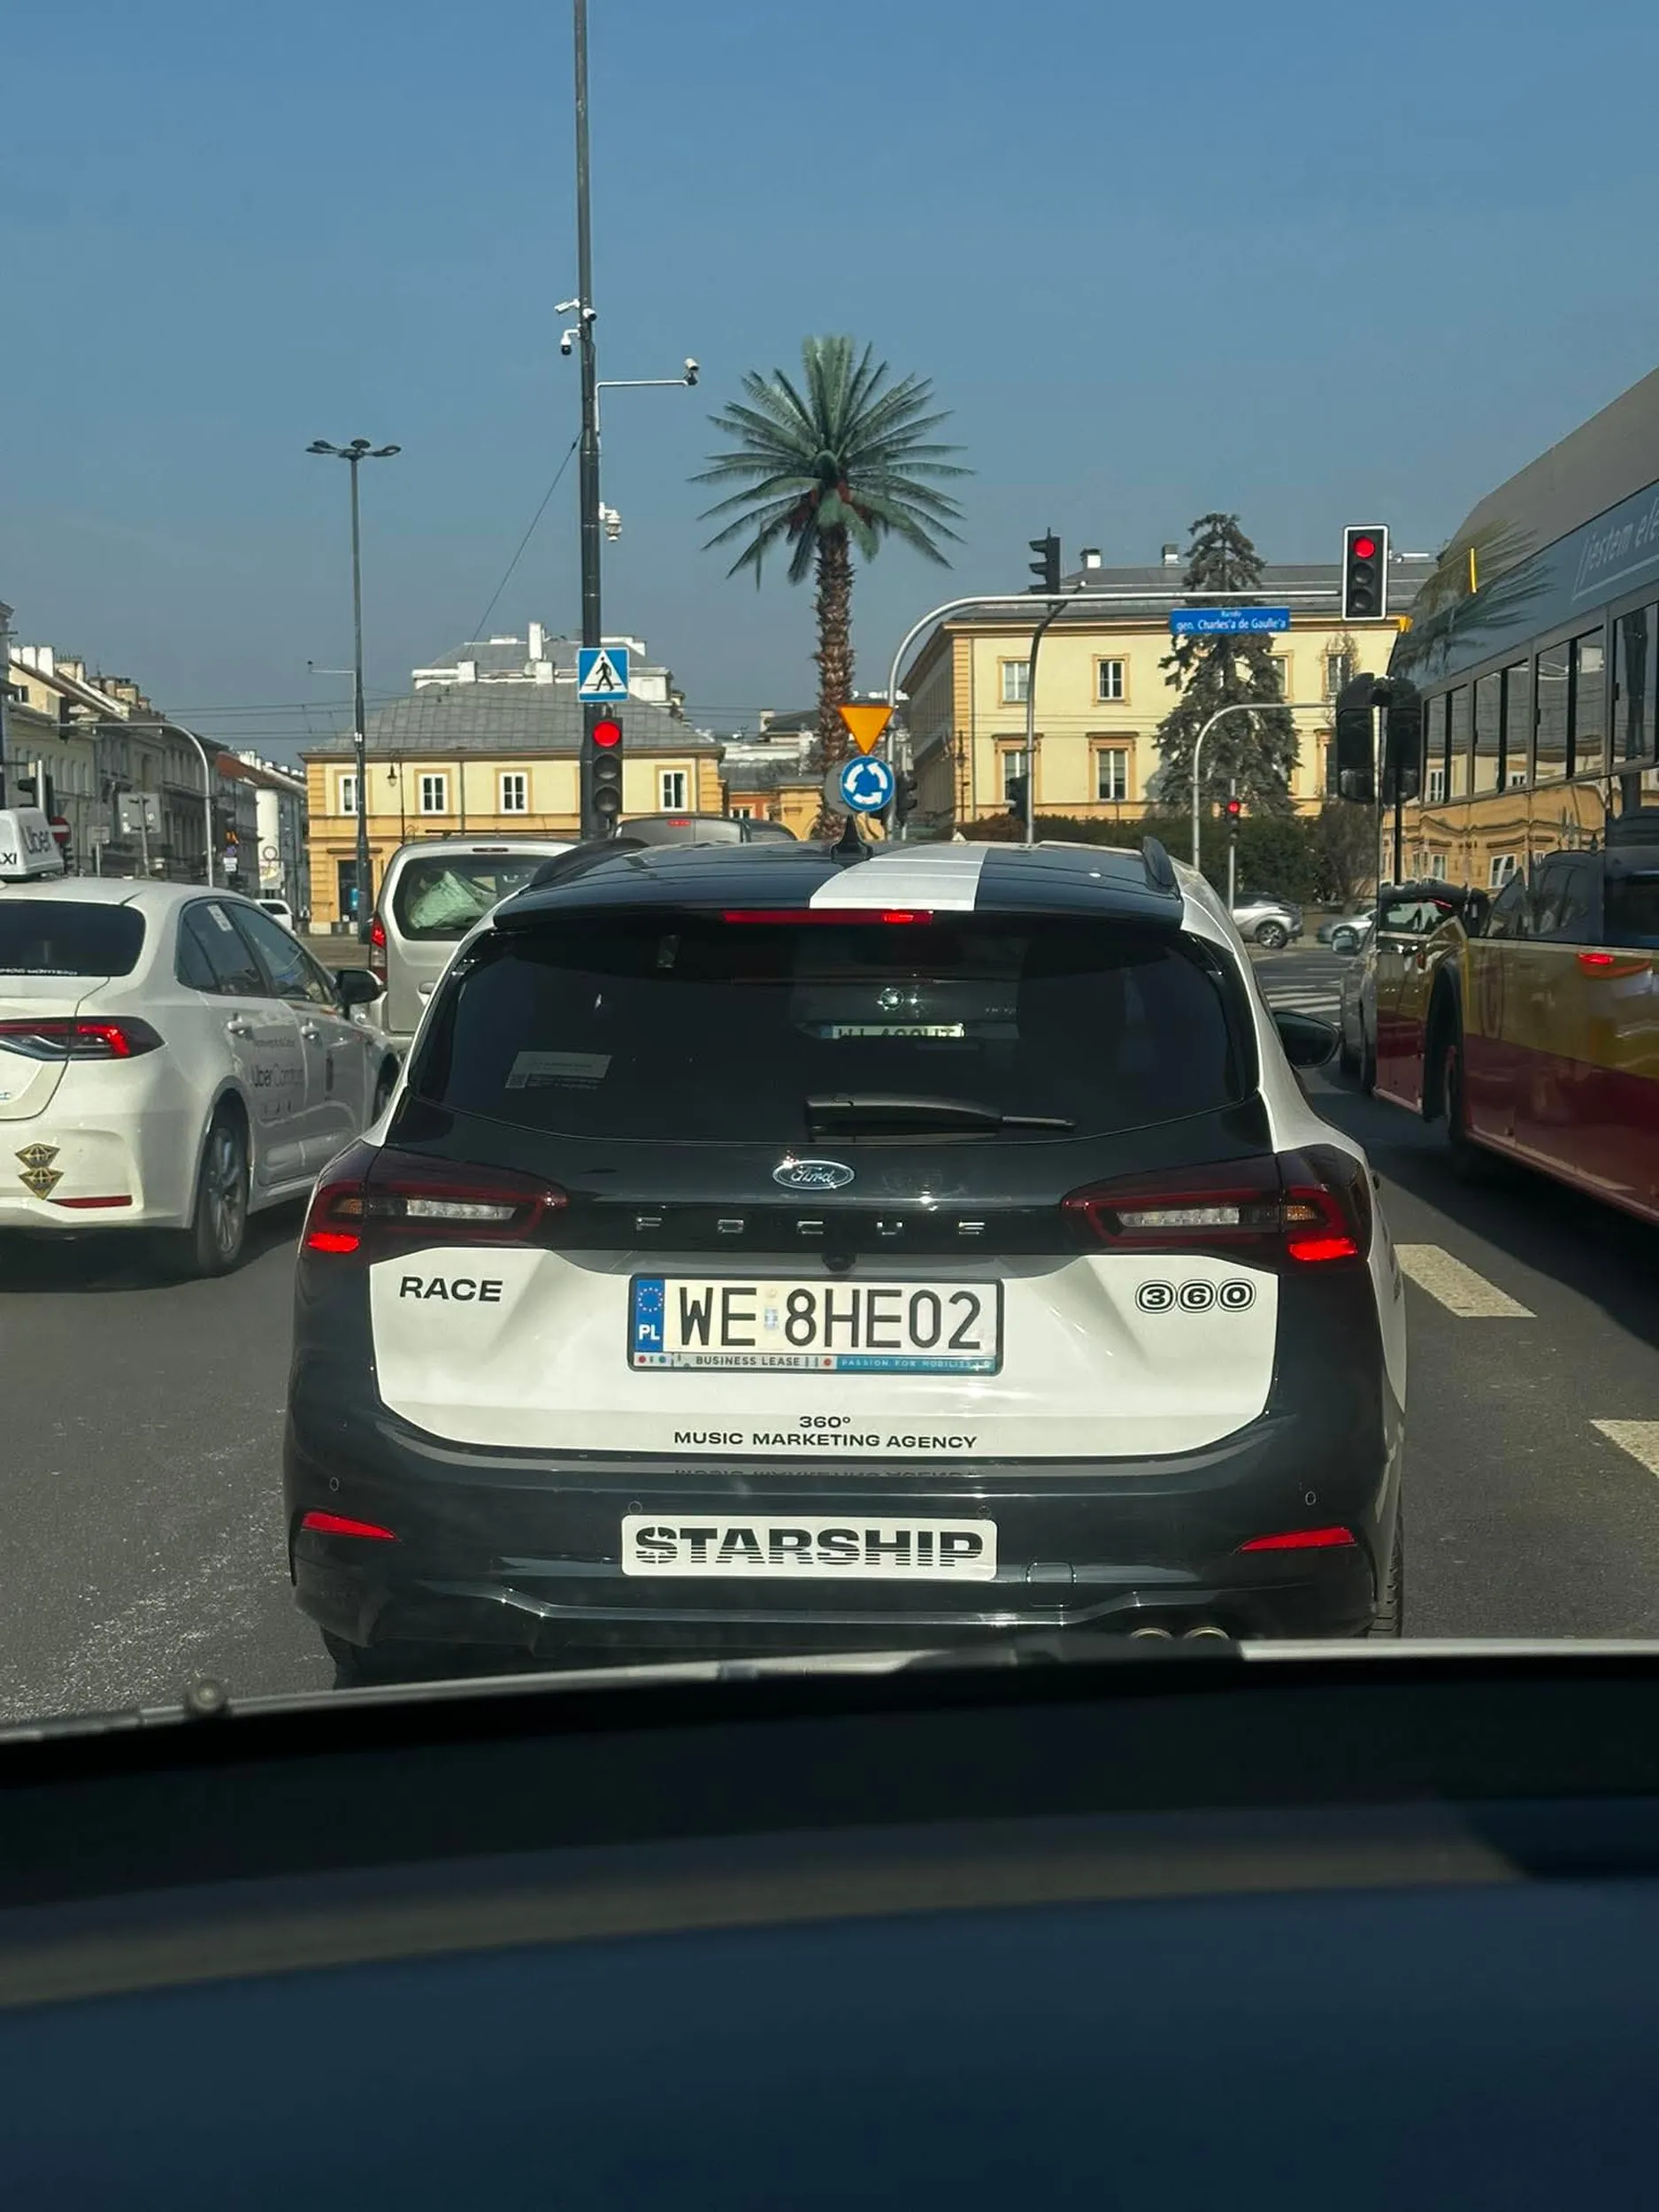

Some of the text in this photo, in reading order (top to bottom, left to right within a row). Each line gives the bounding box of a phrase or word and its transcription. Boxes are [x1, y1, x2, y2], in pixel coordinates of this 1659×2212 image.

[1176, 617, 1286, 633] gen. Charles'a de Gaulle'a
[791, 1165, 836, 1182] Ford
[636, 1217, 985, 1235] FOCUS
[399, 1276, 503, 1302] RACE
[1135, 1278, 1256, 1314] 360
[679, 1286, 981, 1350] WE 8HE02
[639, 1324, 660, 1340] PL
[695, 1356, 800, 1367] BUSINESS LEASE
[674, 1432, 977, 1448] MUSIC MARKETING AGENCY
[635, 1527, 983, 1567] STARSHIP
